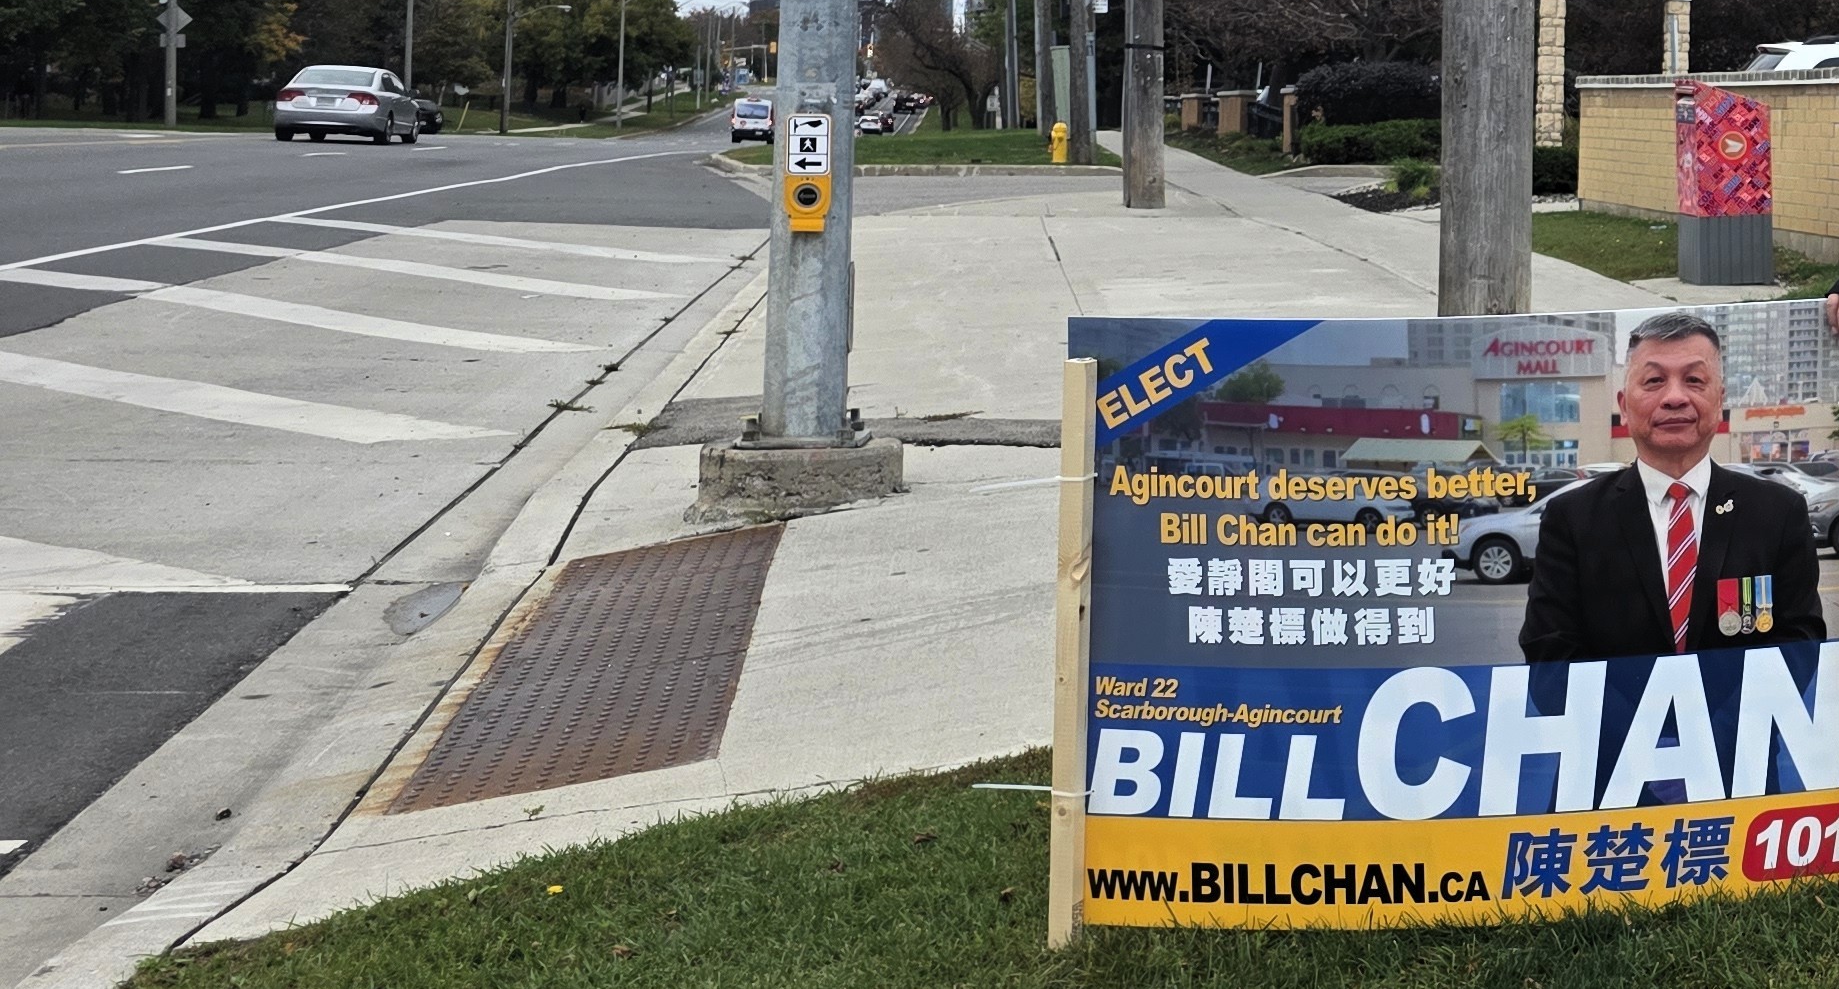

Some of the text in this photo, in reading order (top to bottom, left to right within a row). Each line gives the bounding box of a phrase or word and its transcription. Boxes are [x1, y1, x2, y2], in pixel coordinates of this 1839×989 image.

[1482, 337, 1596, 358] AGINCOURT
[1096, 337, 1214, 430] ELECT
[1516, 359, 1561, 375] MALL
[1109, 465, 1537, 506] Agincourt deserves better,
[1160, 512, 1460, 547] Bill Chan can do it!
[1188, 606, 1436, 646] 陳楚標做得到
[1095, 676, 1178, 698] Ward 22
[1095, 698, 1343, 728] Scarborough-Agincourt
[1087, 728, 1346, 821] BILL
[1501, 816, 1736, 900] 陳楚標
